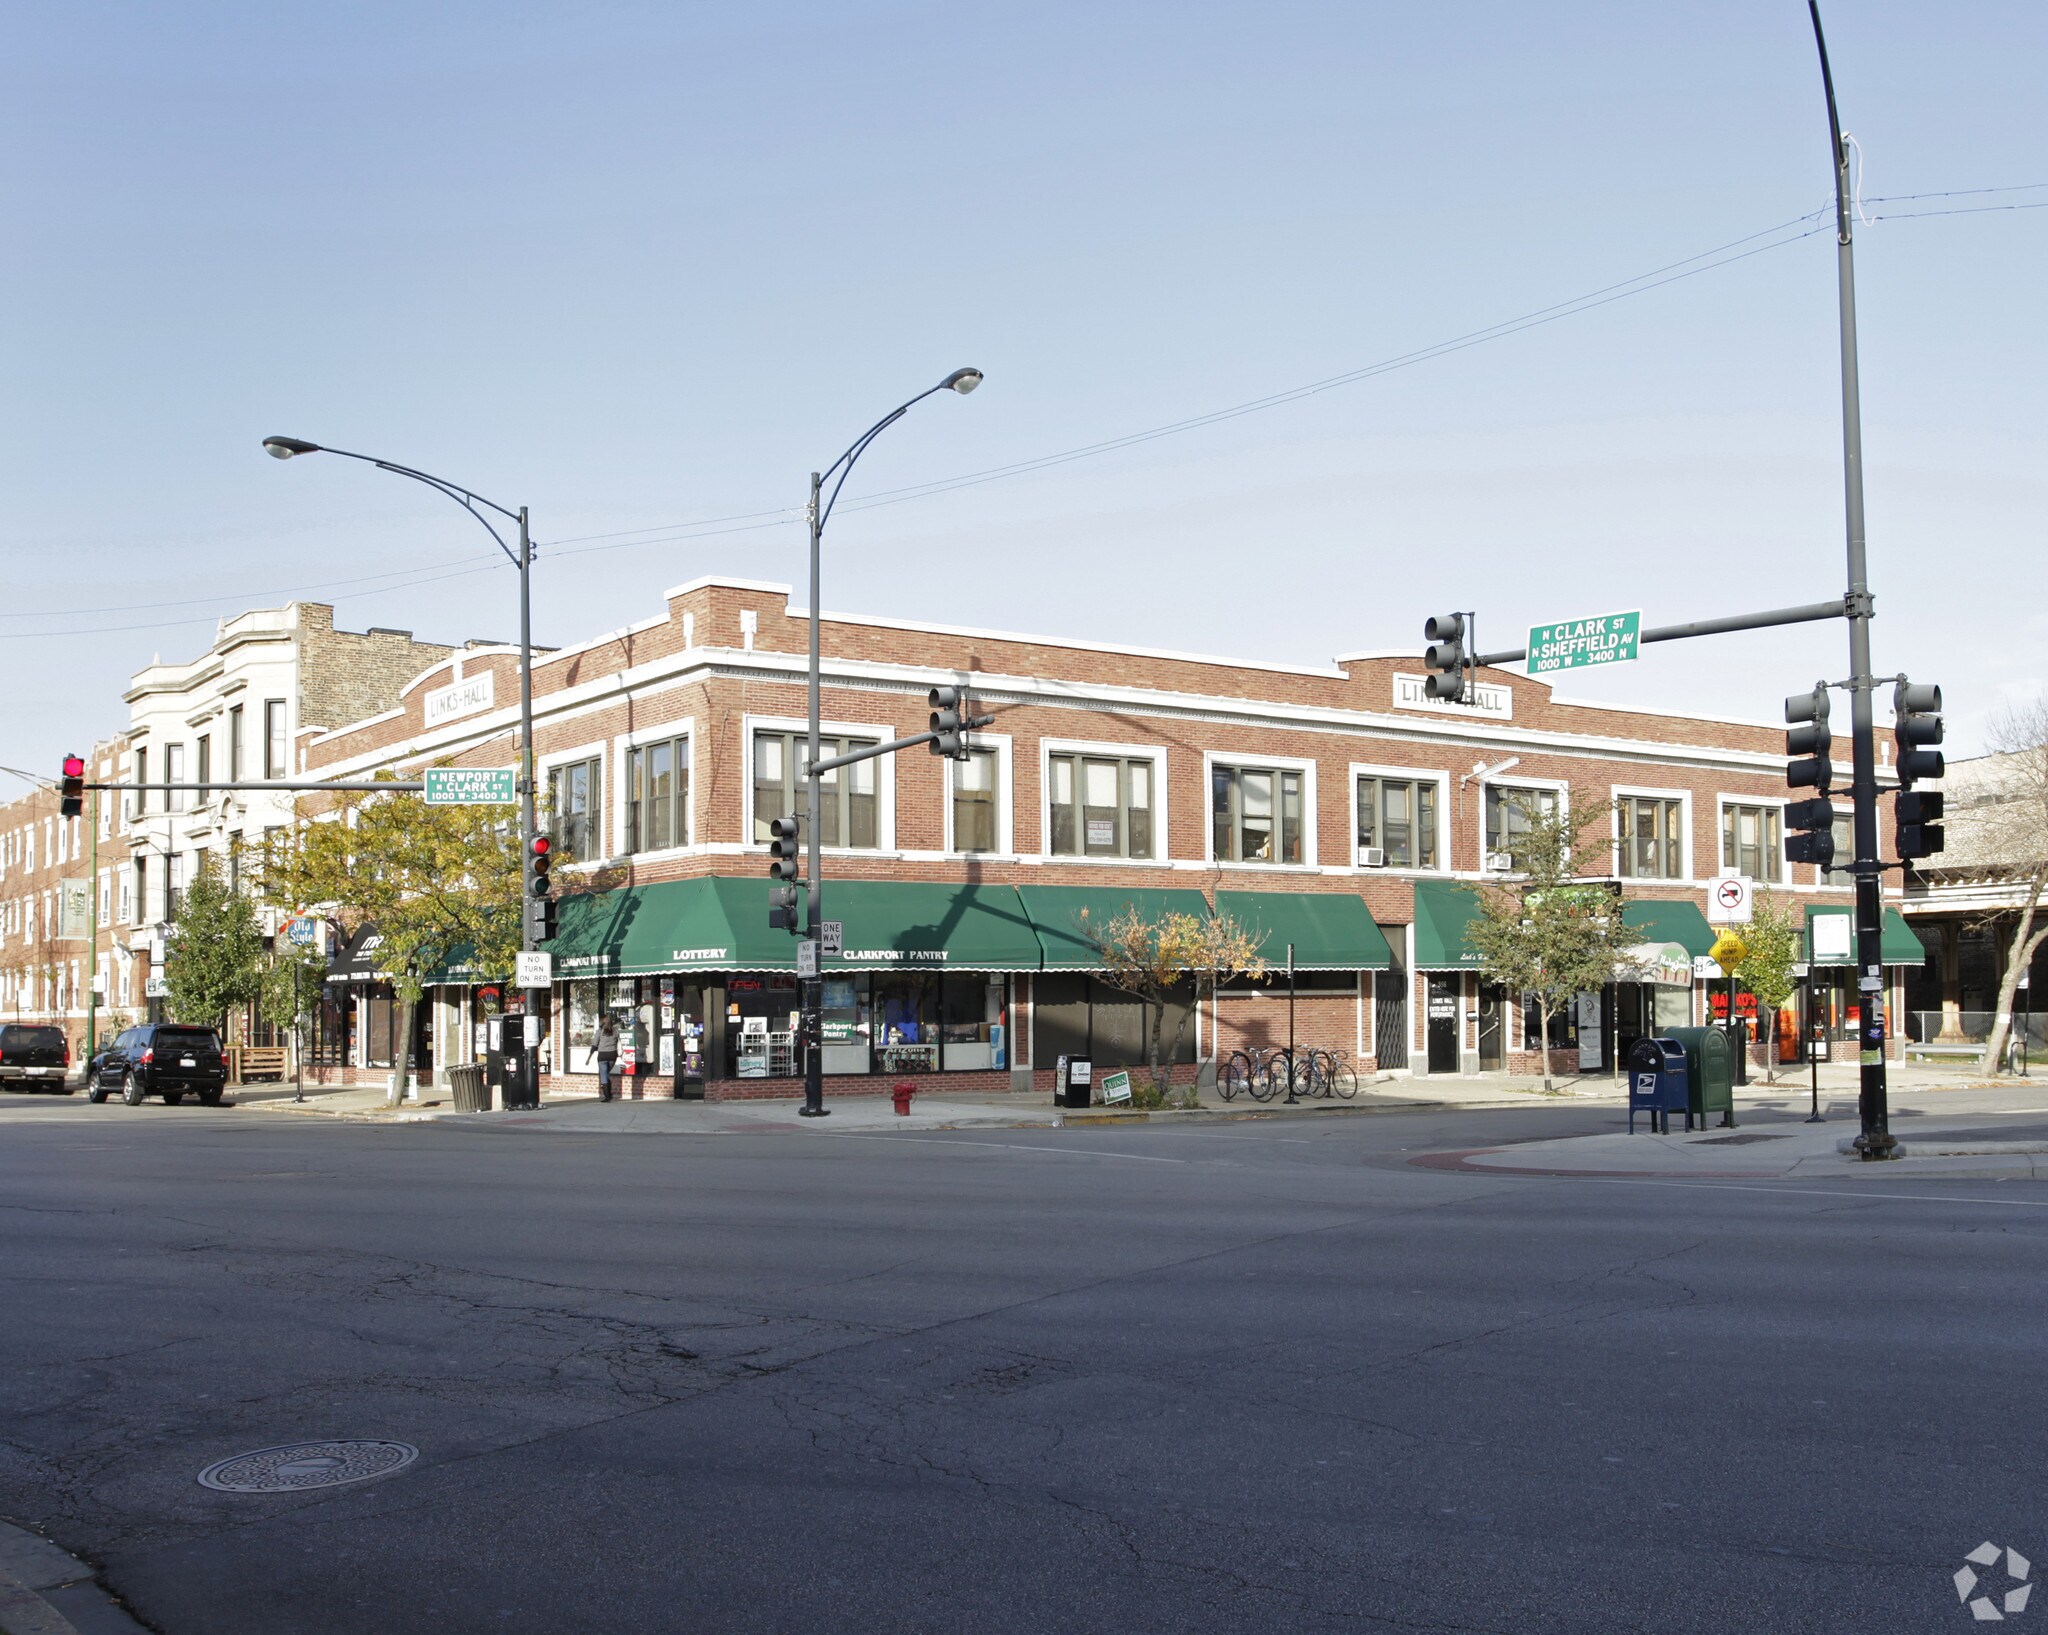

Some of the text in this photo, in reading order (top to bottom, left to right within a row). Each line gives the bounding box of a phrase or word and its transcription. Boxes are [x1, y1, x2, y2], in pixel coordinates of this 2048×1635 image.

[1542, 618, 1625, 640] N CLARK ST
[1532, 633, 1634, 659] N SHEFFIELD AV
[1537, 658, 1560, 671] 1000
[1564, 656, 1573, 666] W
[1587, 650, 1615, 663] 3400
[1619, 648, 1627, 659] N
[440, 772, 497, 782] NEWPORT
[446, 782, 488, 792] CLARK
[432, 792, 455, 800] 1000
[501, 792, 508, 800] N
[294, 921, 311, 932] Old
[823, 923, 840, 932] ONE
[289, 931, 313, 943] Style
[823, 933, 841, 942] WAY
[673, 948, 727, 960] LOTTERY
[843, 951, 948, 960] CLARKPORT PANTRY
[728, 980, 762, 991] OPEN
[823, 1030, 847, 1038] Pantry
[1105, 1078, 1127, 1091] QUINN
